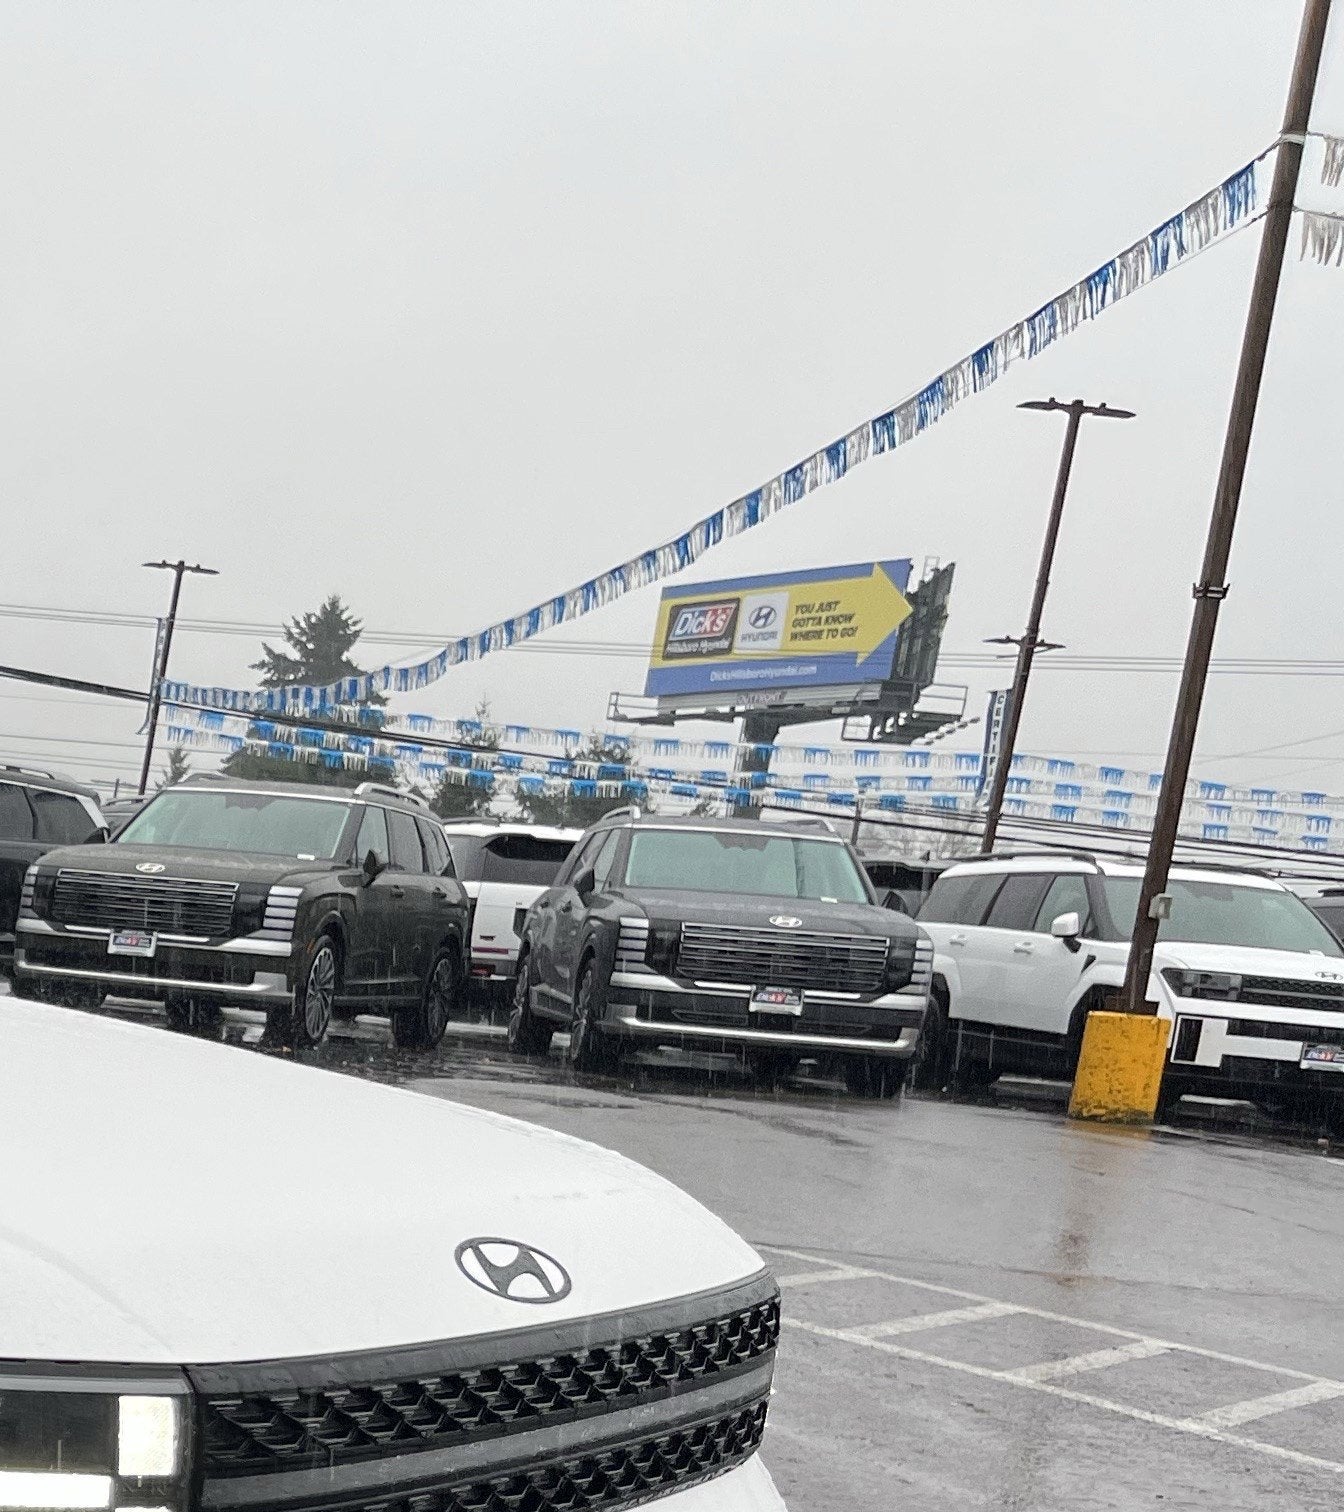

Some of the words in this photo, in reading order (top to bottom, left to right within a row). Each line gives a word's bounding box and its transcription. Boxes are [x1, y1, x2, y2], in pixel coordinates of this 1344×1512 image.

[795, 604, 815, 615] YOU
[816, 600, 840, 613] JUST
[674, 608, 727, 636] Dick's
[792, 615, 822, 628] GOTTA
[824, 613, 855, 625] KNOW
[790, 628, 824, 641] WHERE
[826, 628, 839, 639] TO
